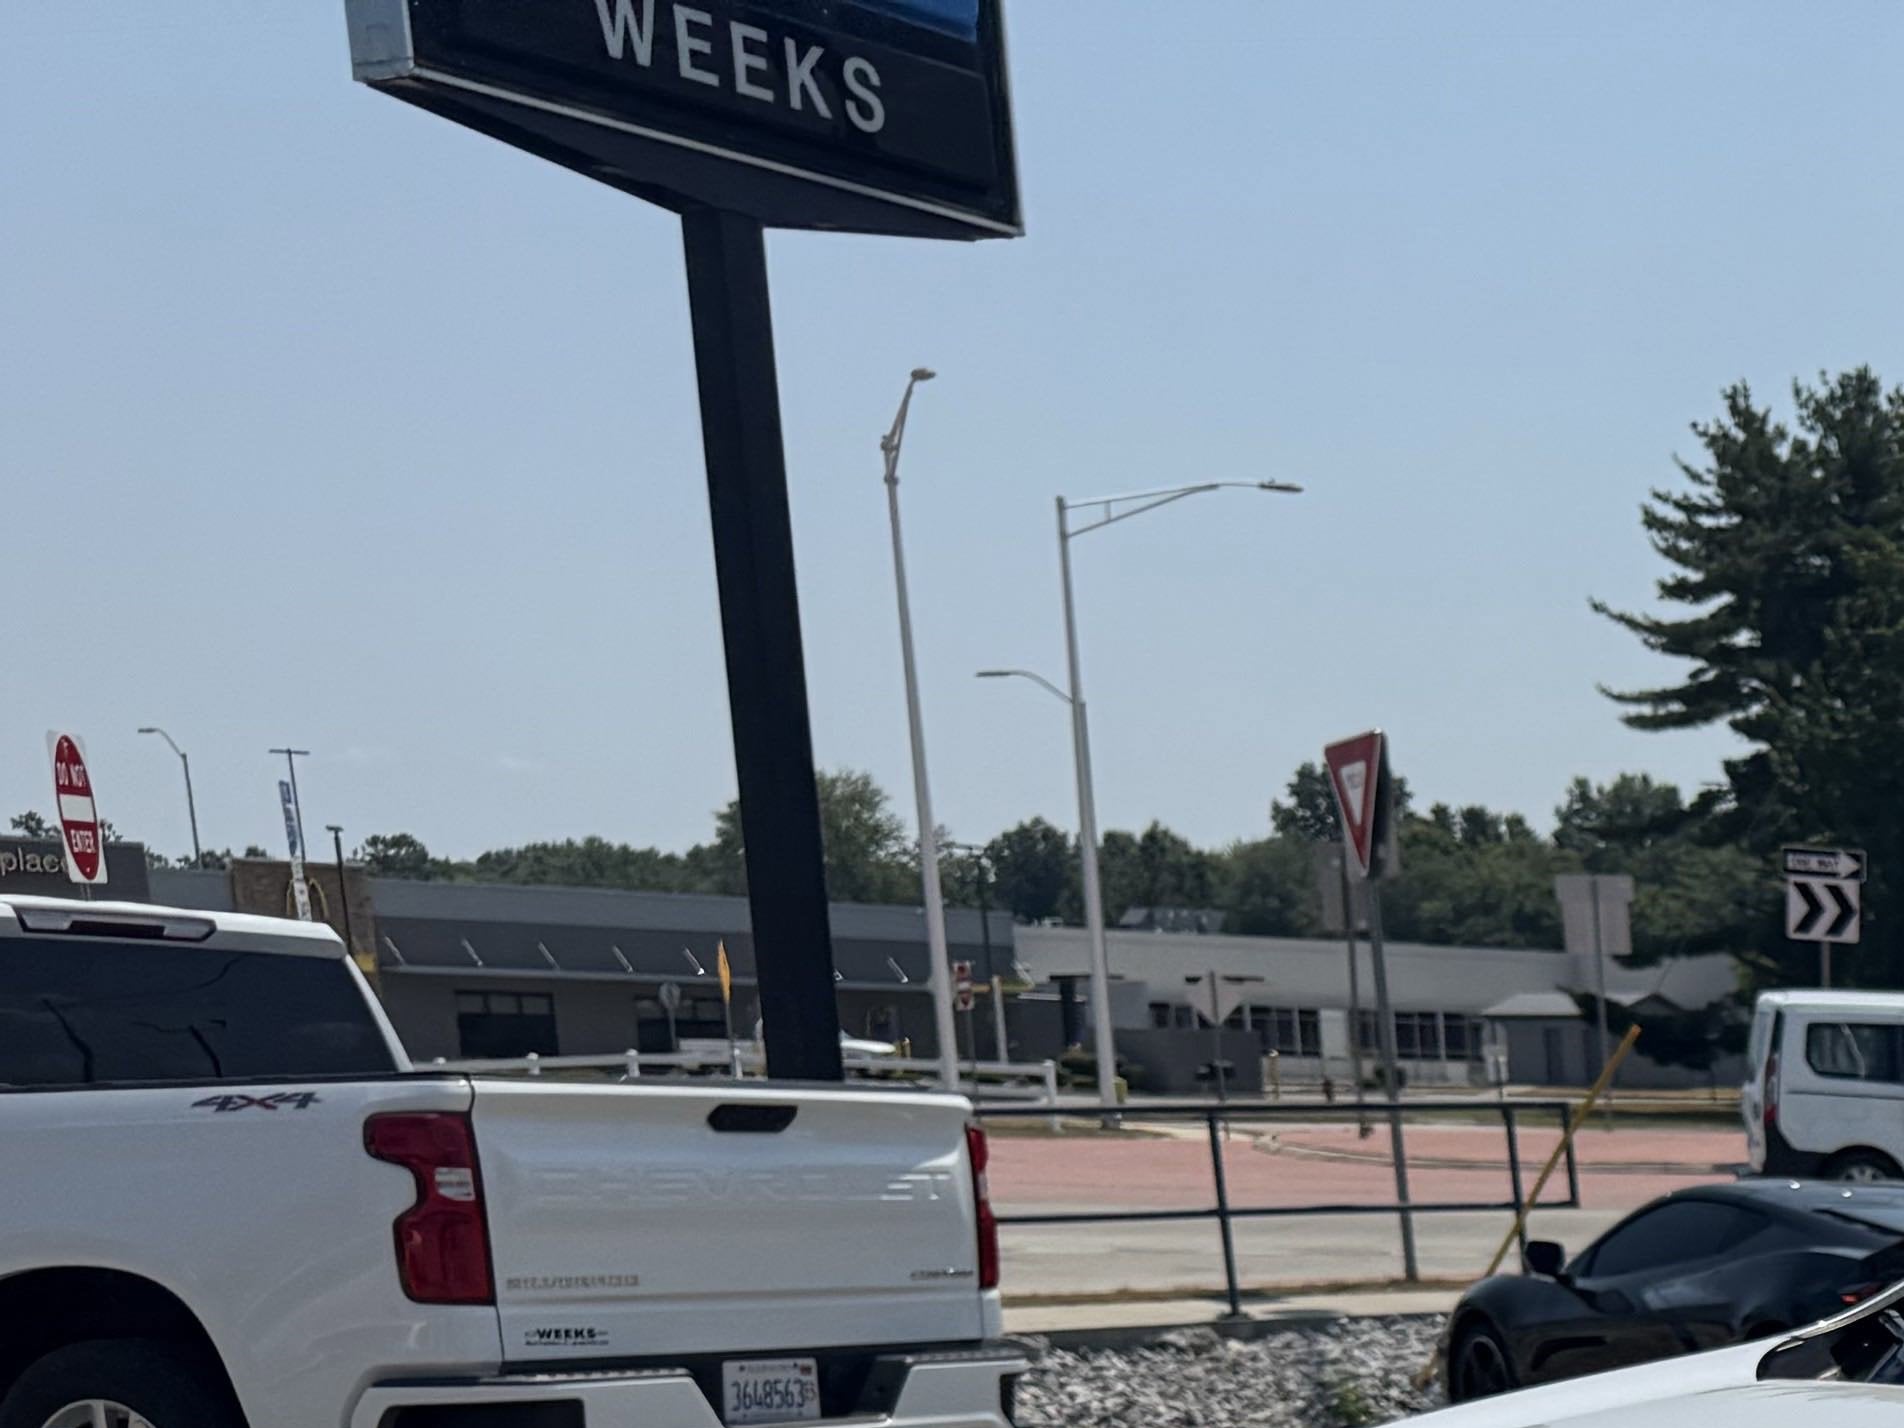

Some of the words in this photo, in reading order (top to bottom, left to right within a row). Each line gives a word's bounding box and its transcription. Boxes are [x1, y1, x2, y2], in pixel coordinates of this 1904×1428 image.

[595, 0, 885, 133] WEEKS
[56, 761, 69, 786] DO
[69, 763, 87, 788] NOT
[70, 828, 96, 854] ENTER
[536, 1328, 597, 1340] WEEKS
[731, 1378, 804, 1411] 3648563
